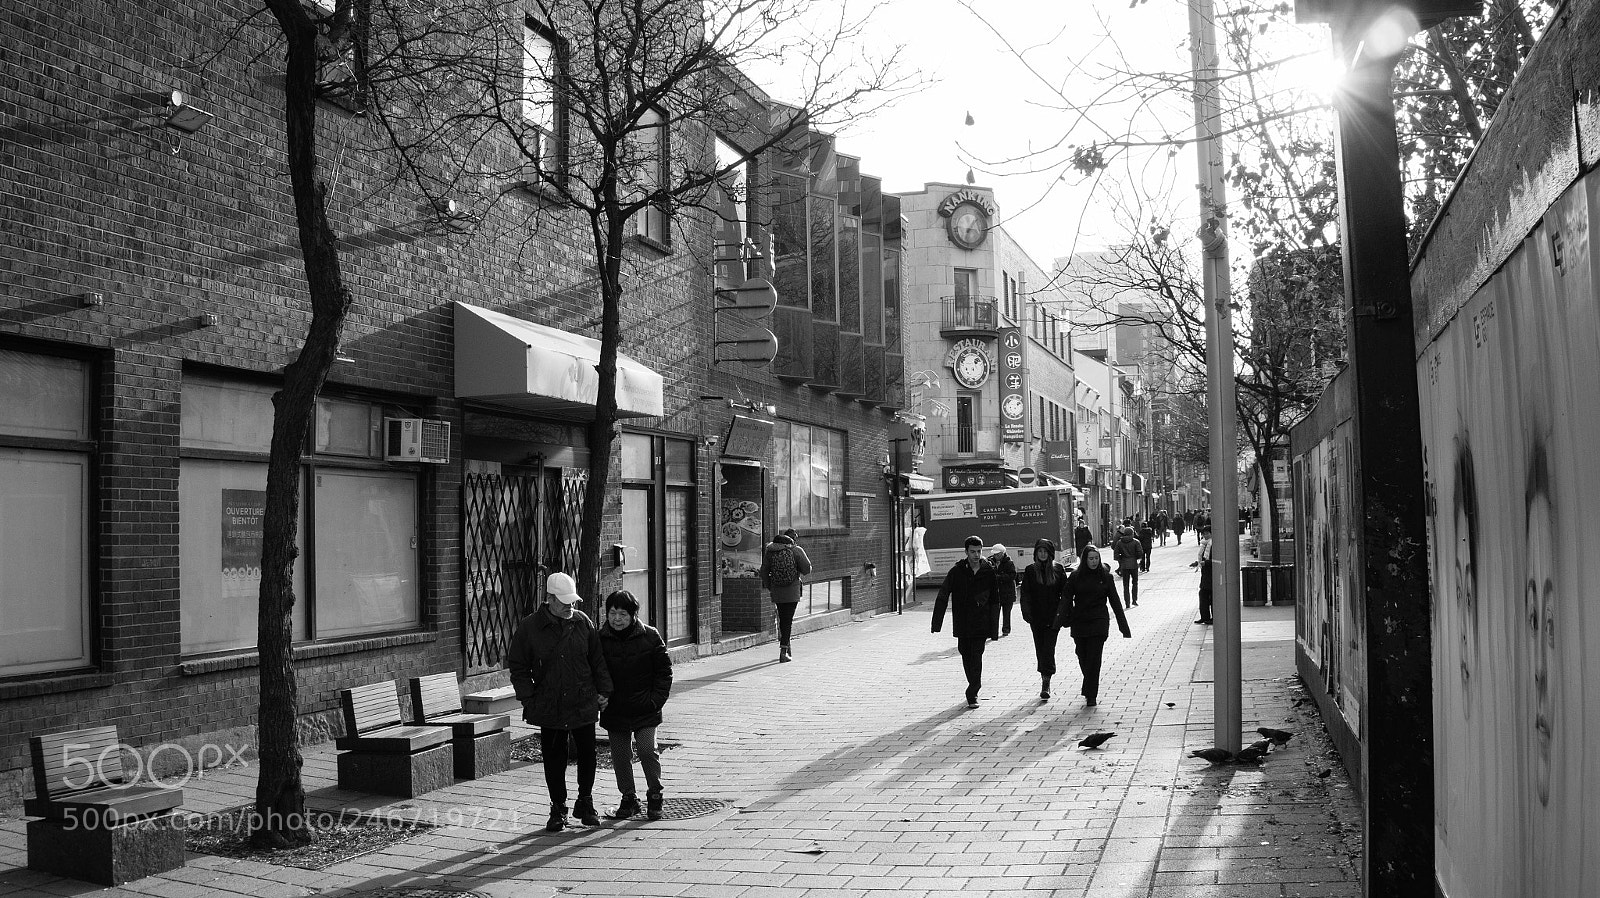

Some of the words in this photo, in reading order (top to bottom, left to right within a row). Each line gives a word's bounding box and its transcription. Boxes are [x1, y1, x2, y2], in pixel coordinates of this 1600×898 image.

[943, 189, 994, 216] NANKING
[226, 507, 264, 516] OUVERTURE
[232, 516, 258, 524] BIENTÔT
